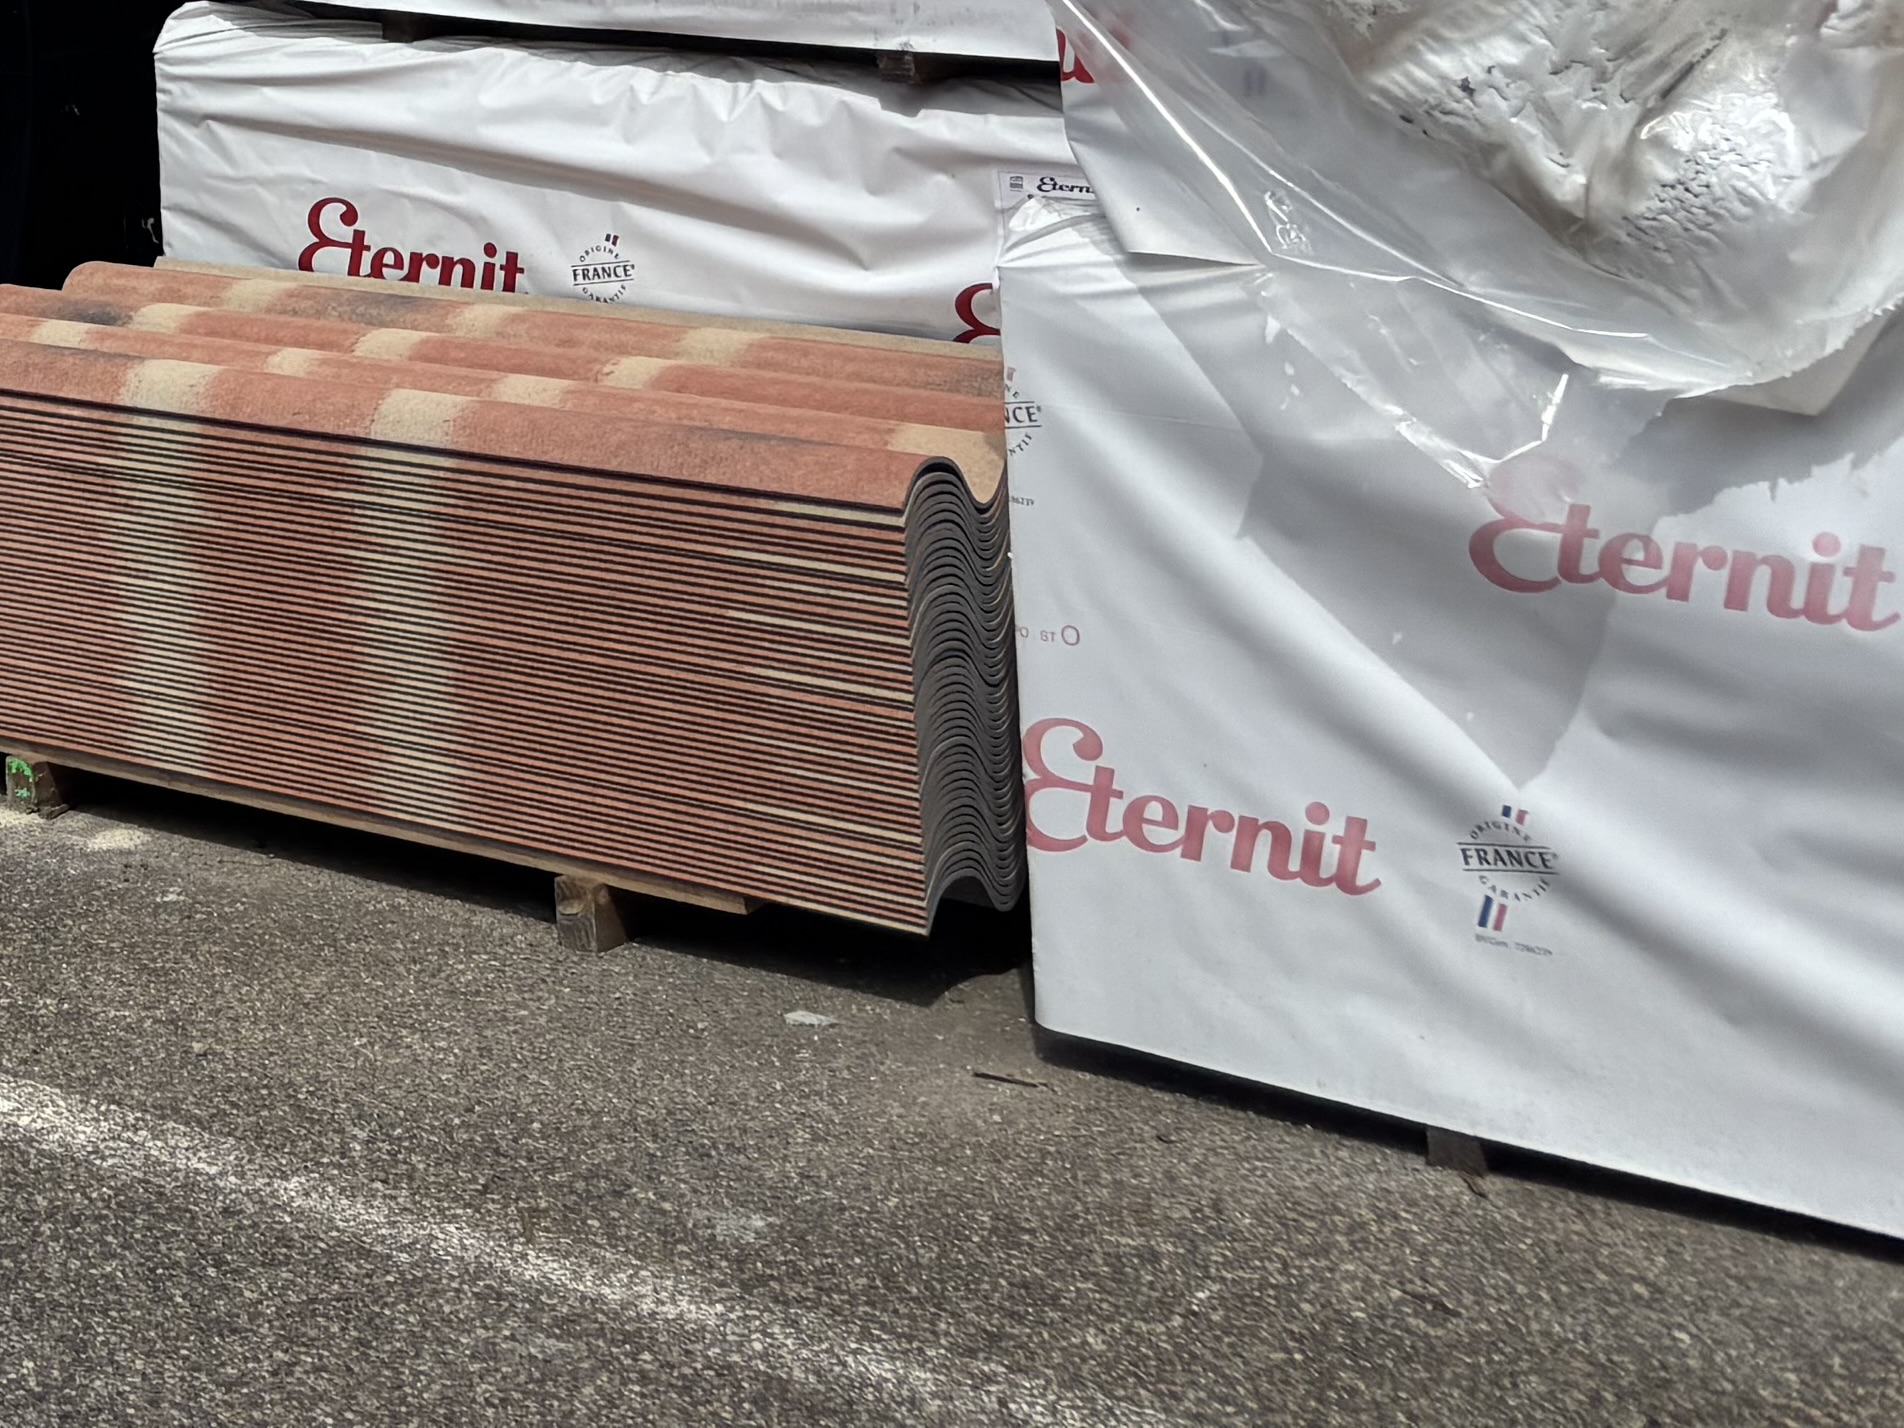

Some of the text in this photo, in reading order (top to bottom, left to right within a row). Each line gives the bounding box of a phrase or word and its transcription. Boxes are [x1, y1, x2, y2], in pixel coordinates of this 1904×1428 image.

[1037, 176, 1093, 193] Etern
[572, 264, 633, 282] FRANCE
[1469, 454, 1901, 632] Eternit
[1021, 718, 1382, 896] Eternit
[1459, 847, 1556, 870] FRANCE
